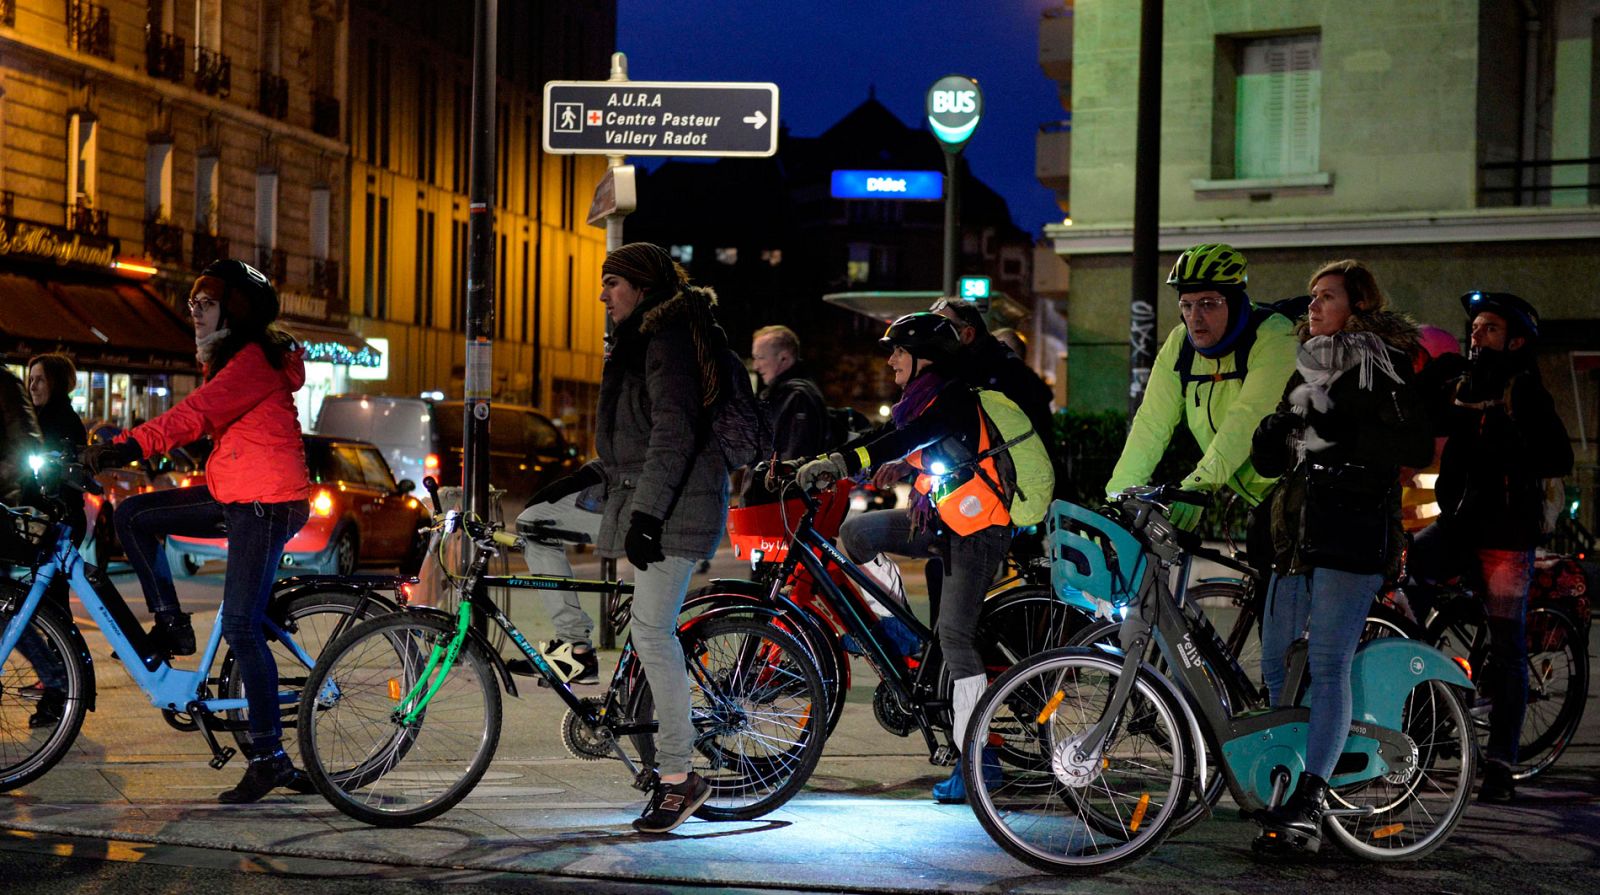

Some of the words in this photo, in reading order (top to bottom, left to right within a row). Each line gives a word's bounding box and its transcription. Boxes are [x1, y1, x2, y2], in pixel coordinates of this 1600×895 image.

[607, 93, 662, 107] A.U.R.A
[933, 90, 976, 113] BUS
[606, 112, 655, 126] Centre
[661, 112, 721, 127] Pasteur
[605, 130, 657, 147] Vallery
[663, 132, 708, 145] Radot
[867, 177, 907, 192] Didot
[761, 539, 775, 553] by
